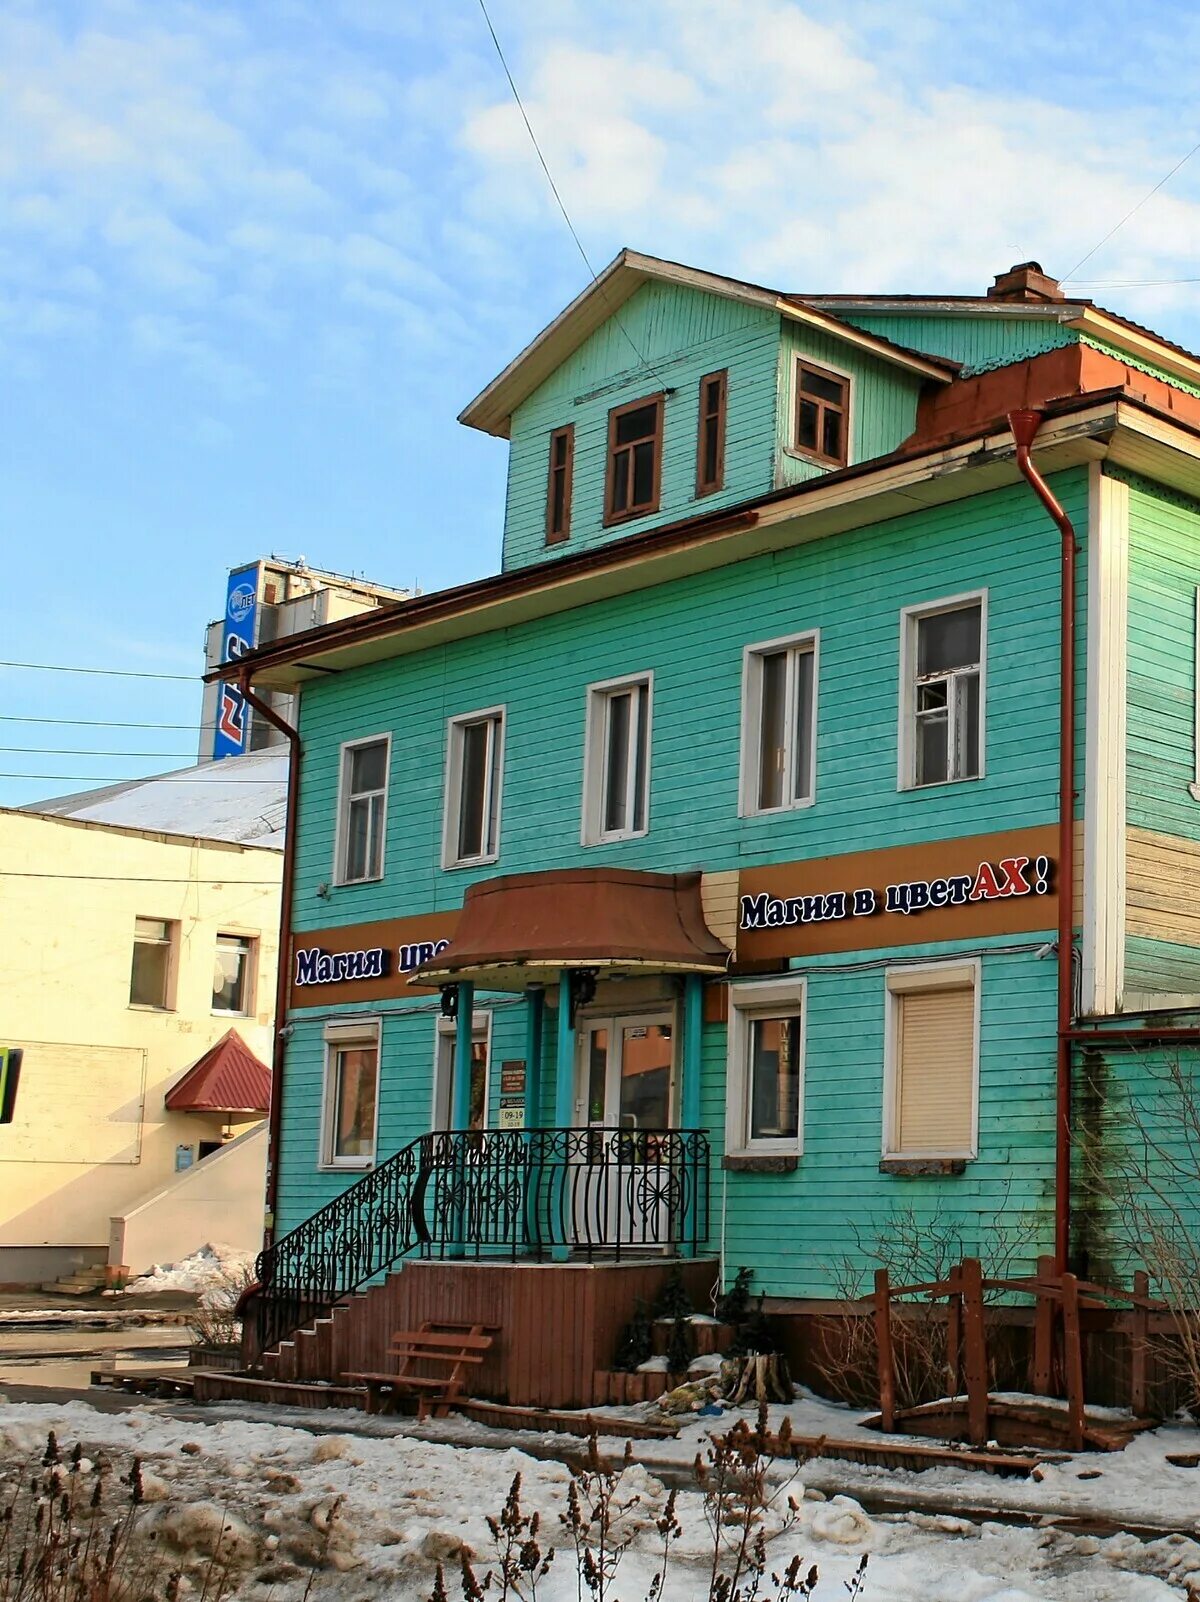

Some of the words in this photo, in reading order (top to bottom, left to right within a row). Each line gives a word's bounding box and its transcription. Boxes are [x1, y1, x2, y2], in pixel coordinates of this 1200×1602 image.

[740, 892, 846, 930] Магия
[853, 888, 875, 916] в
[295, 947, 383, 986] Магия
[504, 1111, 524, 1120] 09-19
